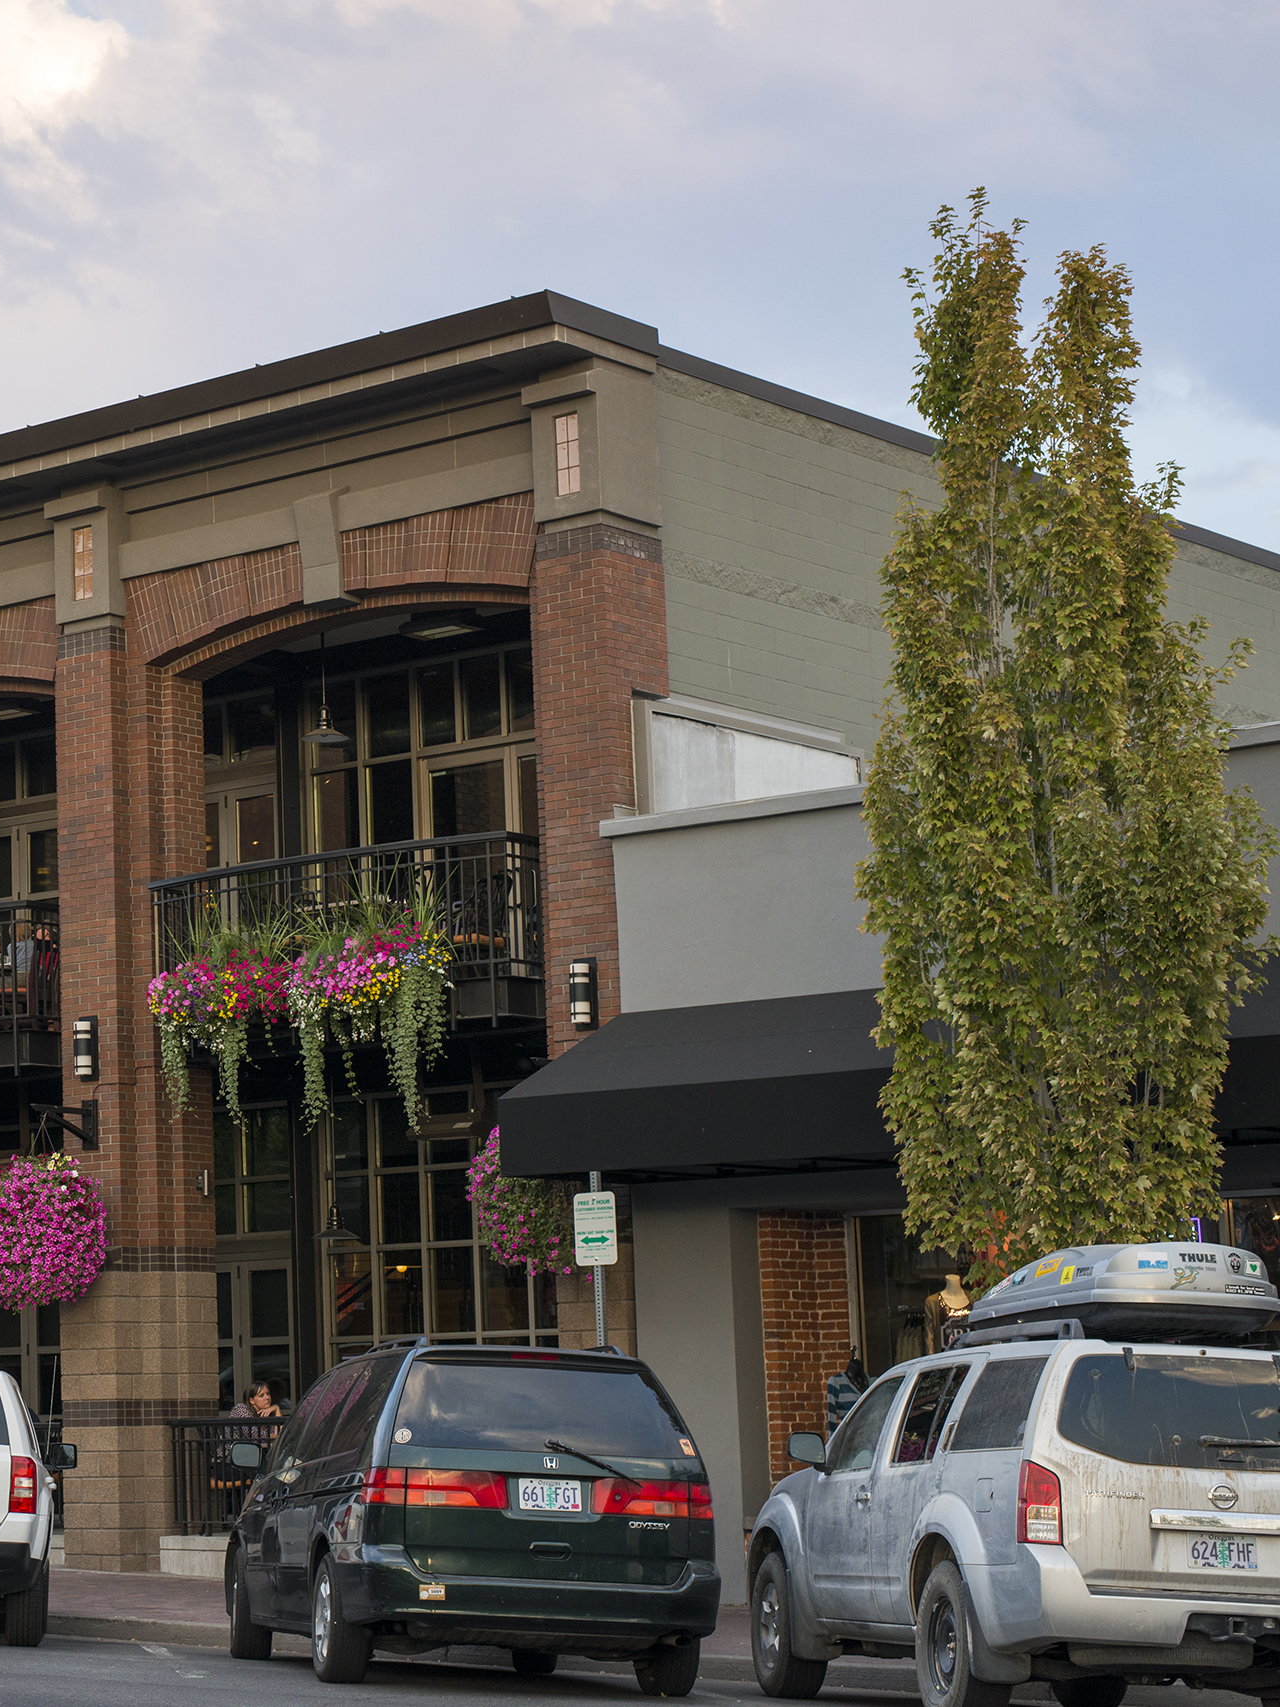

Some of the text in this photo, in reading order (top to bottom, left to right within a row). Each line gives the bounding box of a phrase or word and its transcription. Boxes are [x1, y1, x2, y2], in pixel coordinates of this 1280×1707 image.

[1179, 1252, 1217, 1263] THULE
[522, 1485, 578, 1504] 661 FGT
[1085, 1489, 1146, 1500] PATHFINDER
[628, 1520, 670, 1530] ODYSSEY
[1208, 1533, 1234, 1542] Oregon
[1191, 1540, 1254, 1562] 624 FHF
